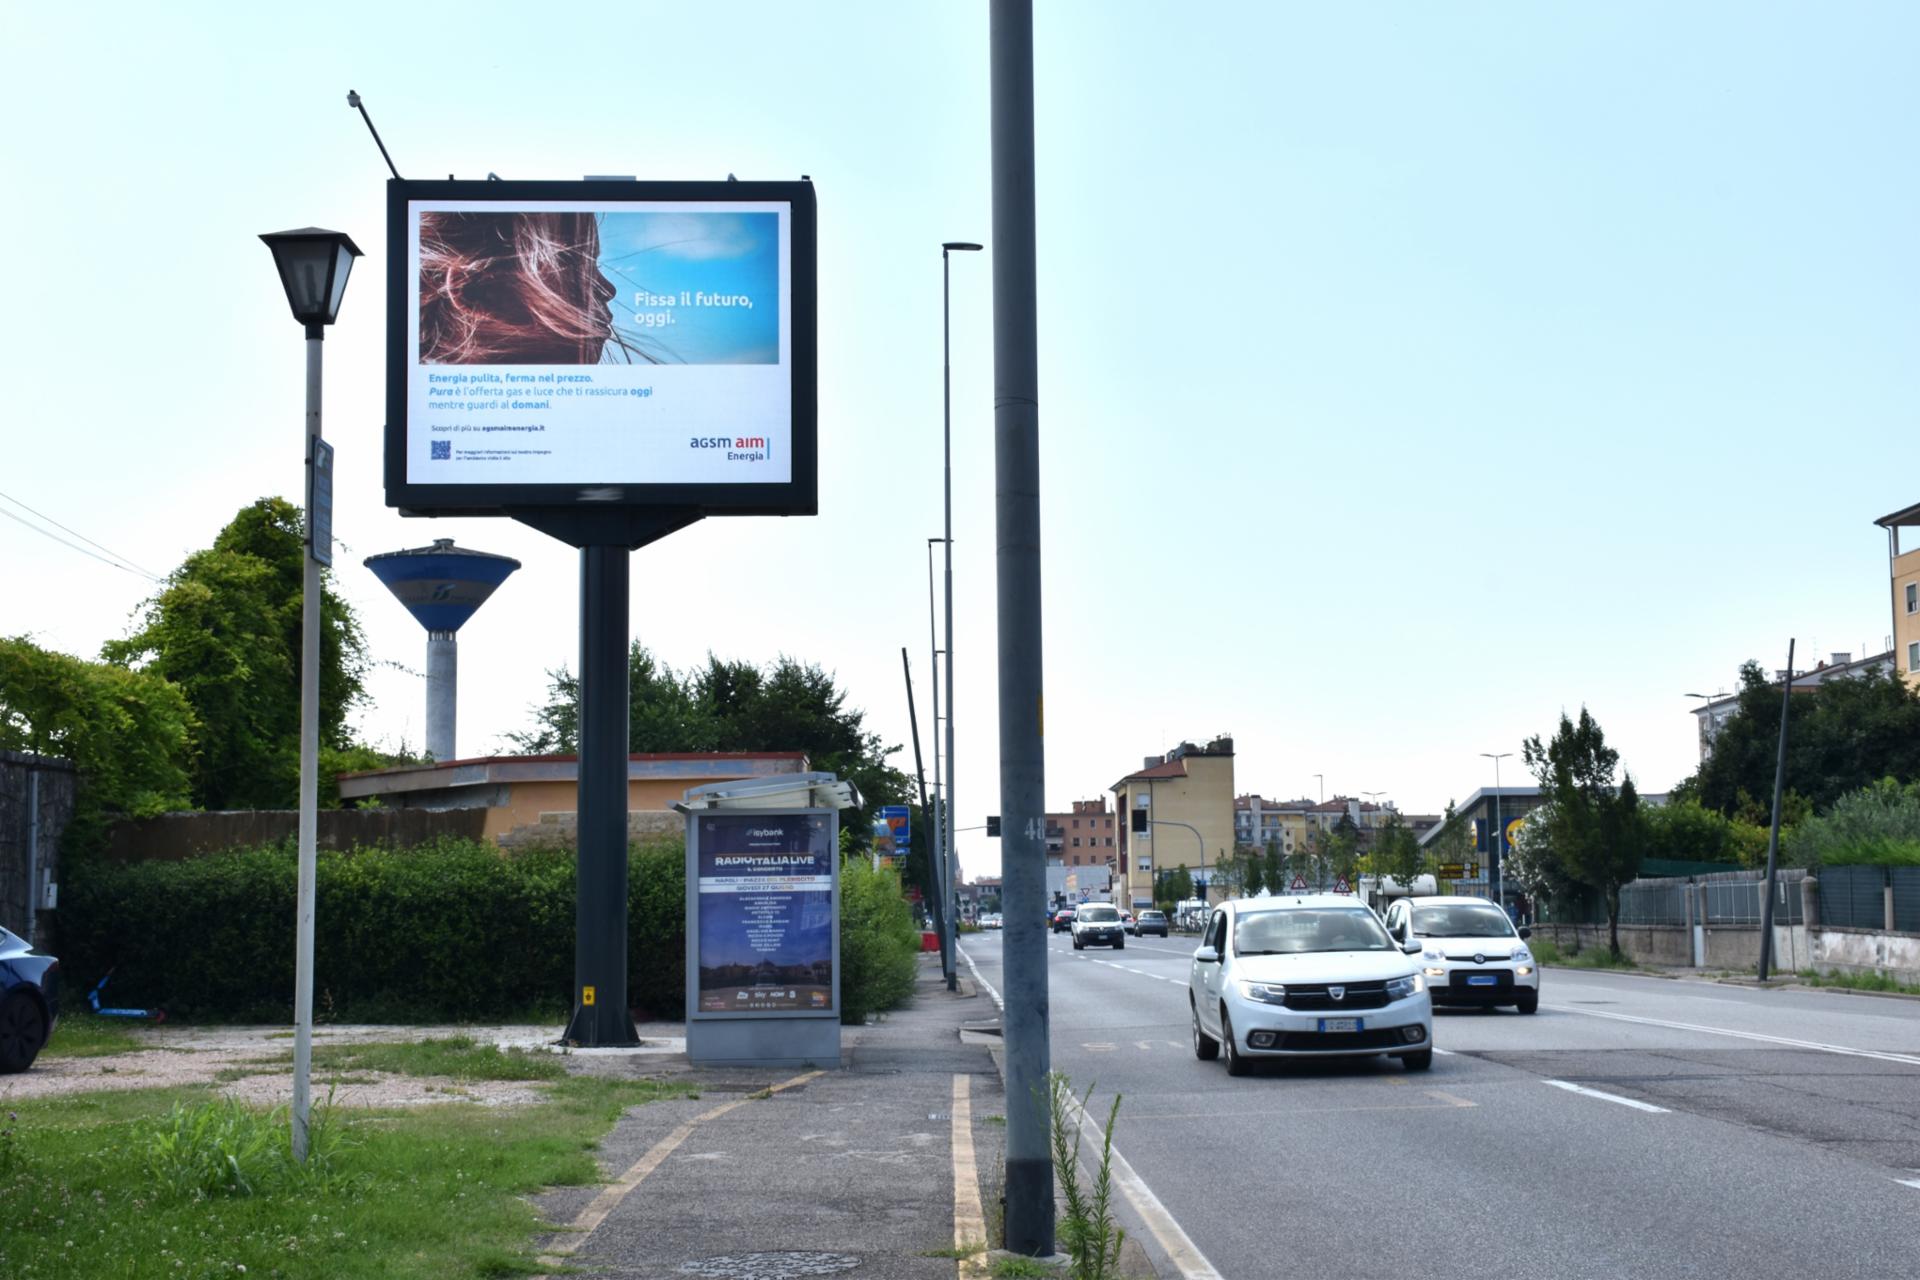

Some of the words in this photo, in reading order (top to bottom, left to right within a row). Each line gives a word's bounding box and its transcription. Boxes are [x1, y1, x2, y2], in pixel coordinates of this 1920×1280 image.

[634, 291, 676, 306] Fissa
[681, 291, 692, 306] il
[696, 291, 753, 309] futuro,
[634, 309, 676, 327] oggi.
[428, 373, 468, 384] Energia
[470, 373, 503, 384] pulita,
[505, 373, 536, 383] ferma
[538, 373, 554, 383] nel
[557, 375, 593, 384] prezzo.
[429, 386, 454, 396] Pura
[455, 386, 461, 396] è
[464, 386, 504, 396] l'offerta
[506, 388, 523, 397] gas
[525, 388, 532, 396] e
[533, 386, 554, 396] luce
[556, 386, 573, 396] che
[576, 386, 583, 396] ti
[585, 387, 628, 396] rassicura
[630, 386, 653, 397] oggi
[428, 401, 465, 410] mentre
[467, 400, 498, 411] guardi
[500, 400, 509, 410] al
[511, 400, 552, 410] domani.
[431, 424, 452, 433] Scopri
[735, 437, 765, 449] aim
[727, 451, 764, 462] Energia
